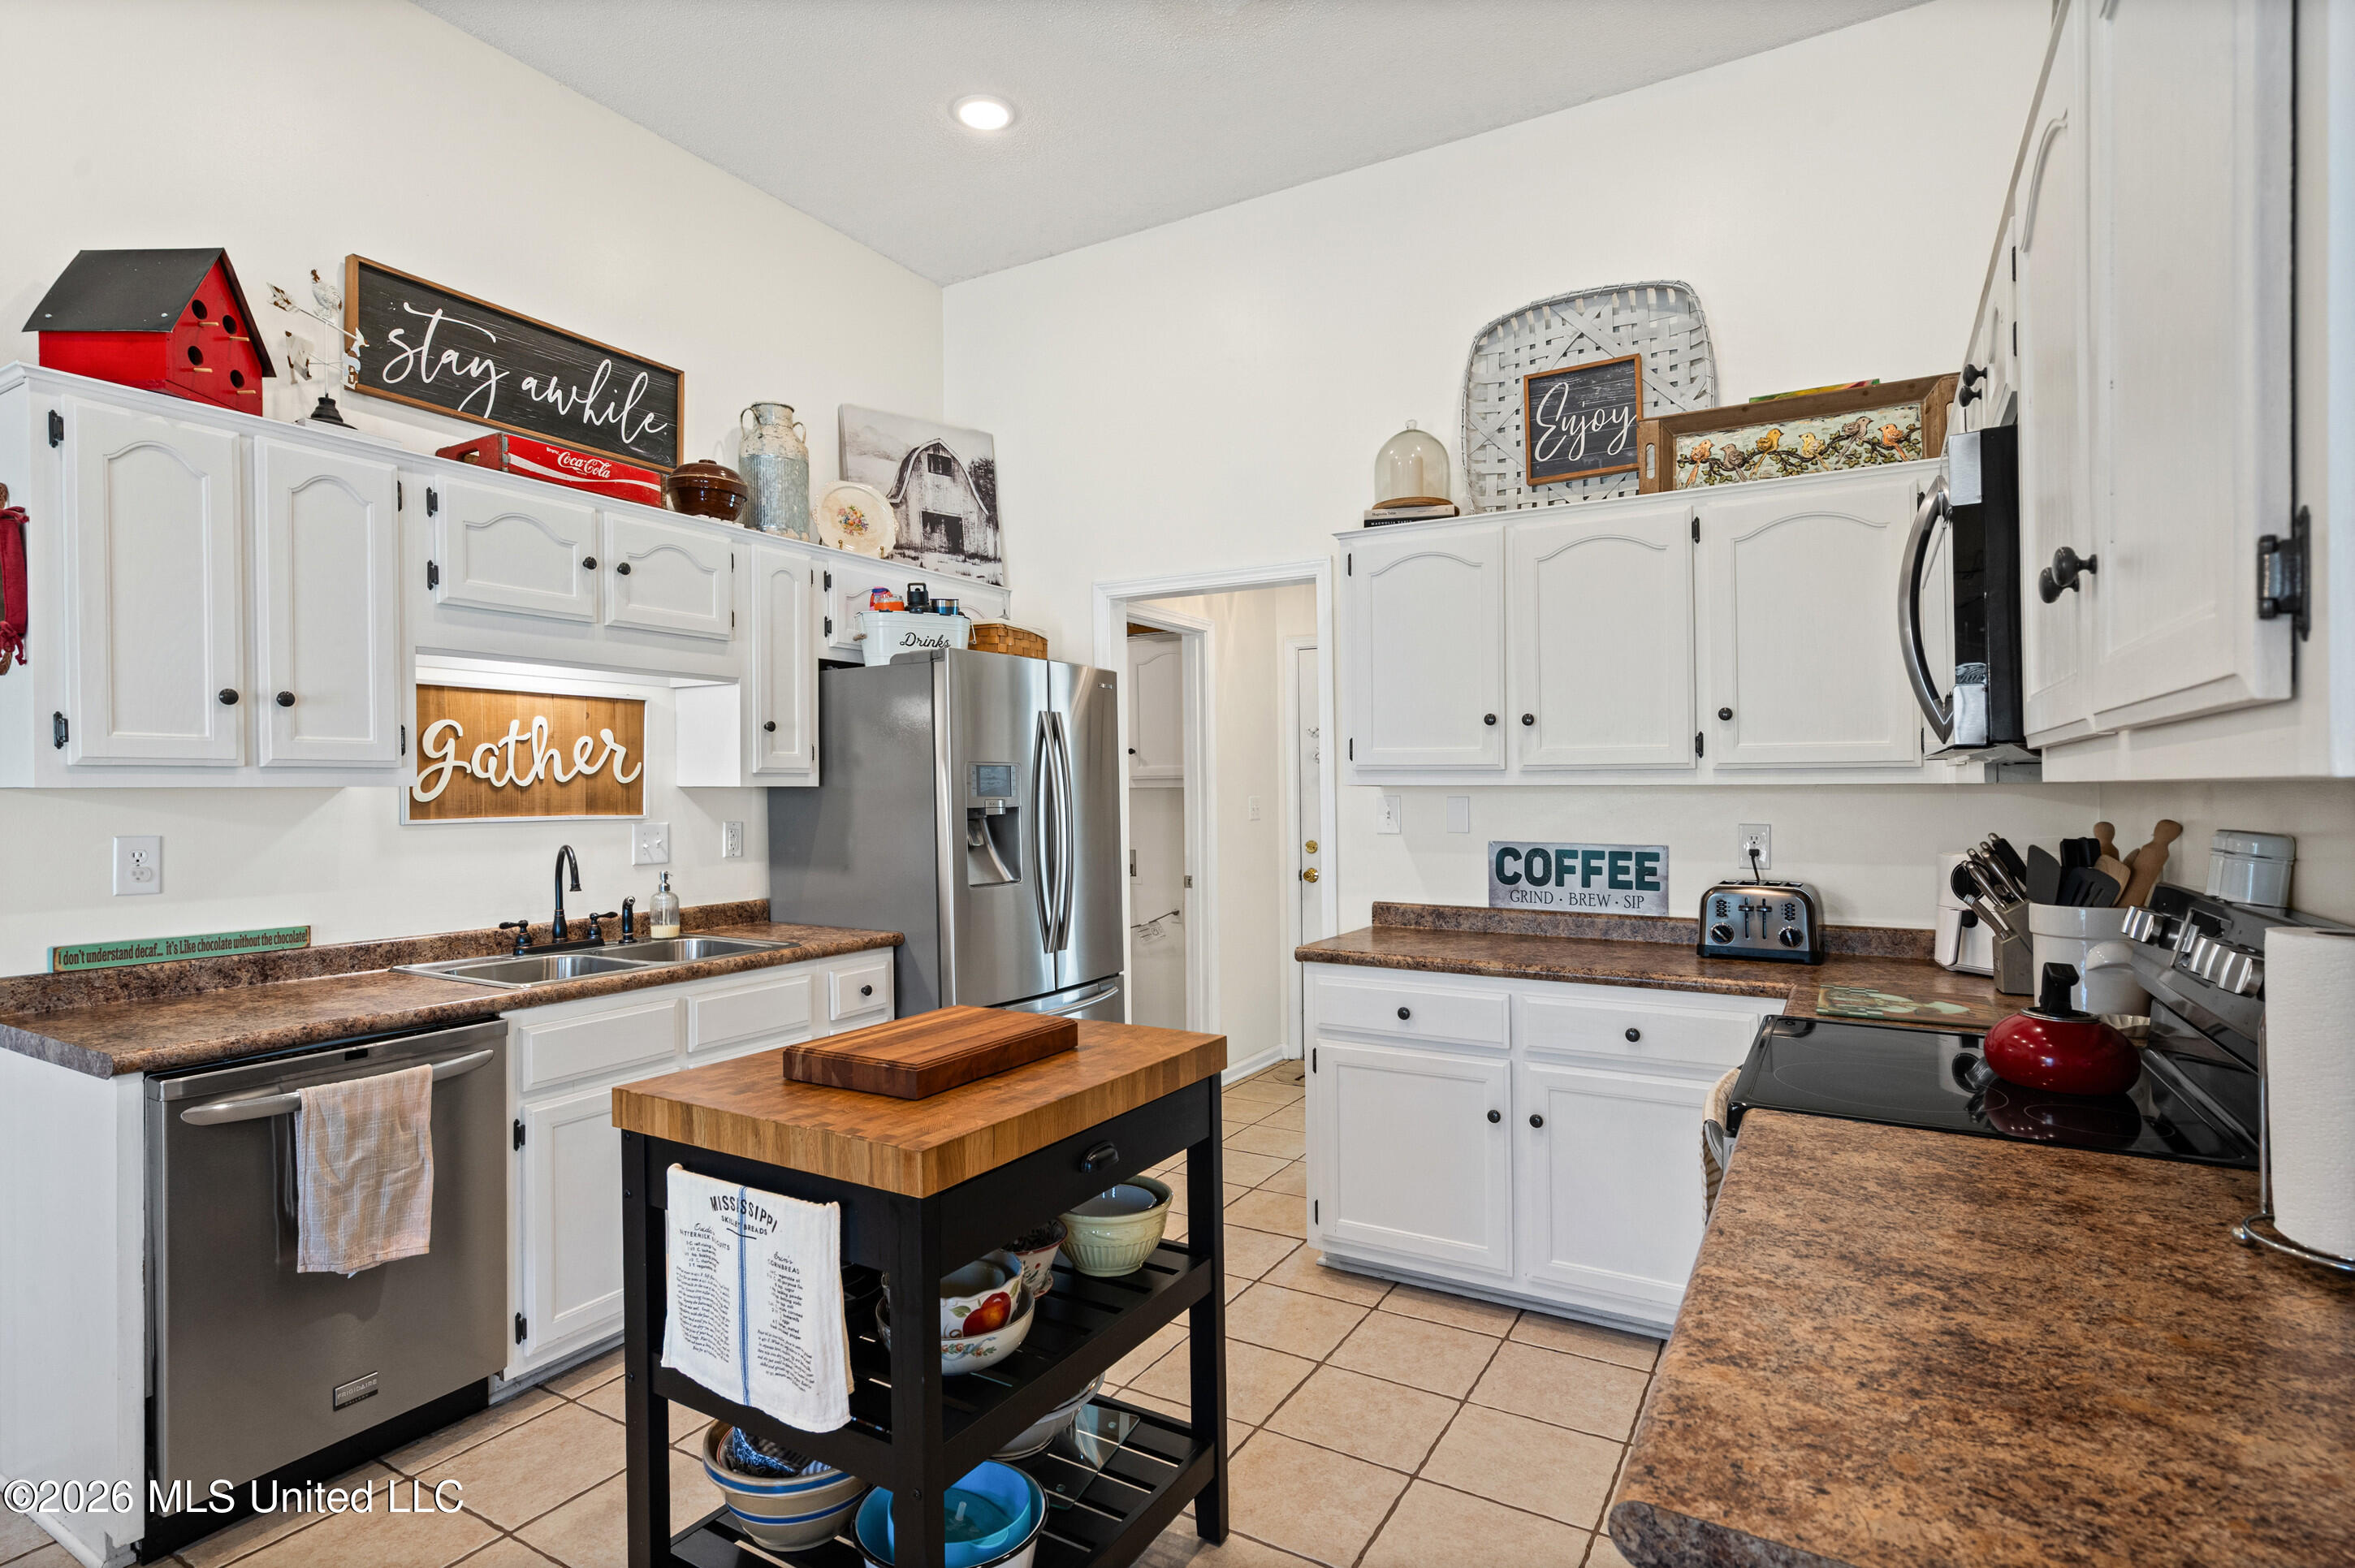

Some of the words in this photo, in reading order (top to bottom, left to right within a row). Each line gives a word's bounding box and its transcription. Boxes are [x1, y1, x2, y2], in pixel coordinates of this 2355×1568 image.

[382, 301, 510, 419] stay
[1534, 382, 1637, 462] Enjoy
[899, 633, 951, 649] Drinks
[1495, 846, 1661, 892] COFFEE
[1510, 889, 1553, 905] GRIND
[1569, 892, 1611, 908] BREW
[1623, 895, 1644, 909] SIP
[63, 949, 85, 965] don't
[86, 944, 133, 963] understand
[179, 939, 196, 954] Like
[197, 936, 232, 952] chocolate
[233, 934, 261, 948] without
[261, 933, 273, 945] the
[710, 1195, 777, 1233] MISSISSIPPI
[744, 1224, 767, 1235] BREADS
[337, 1379, 378, 1399] FRIGIDAIRE
